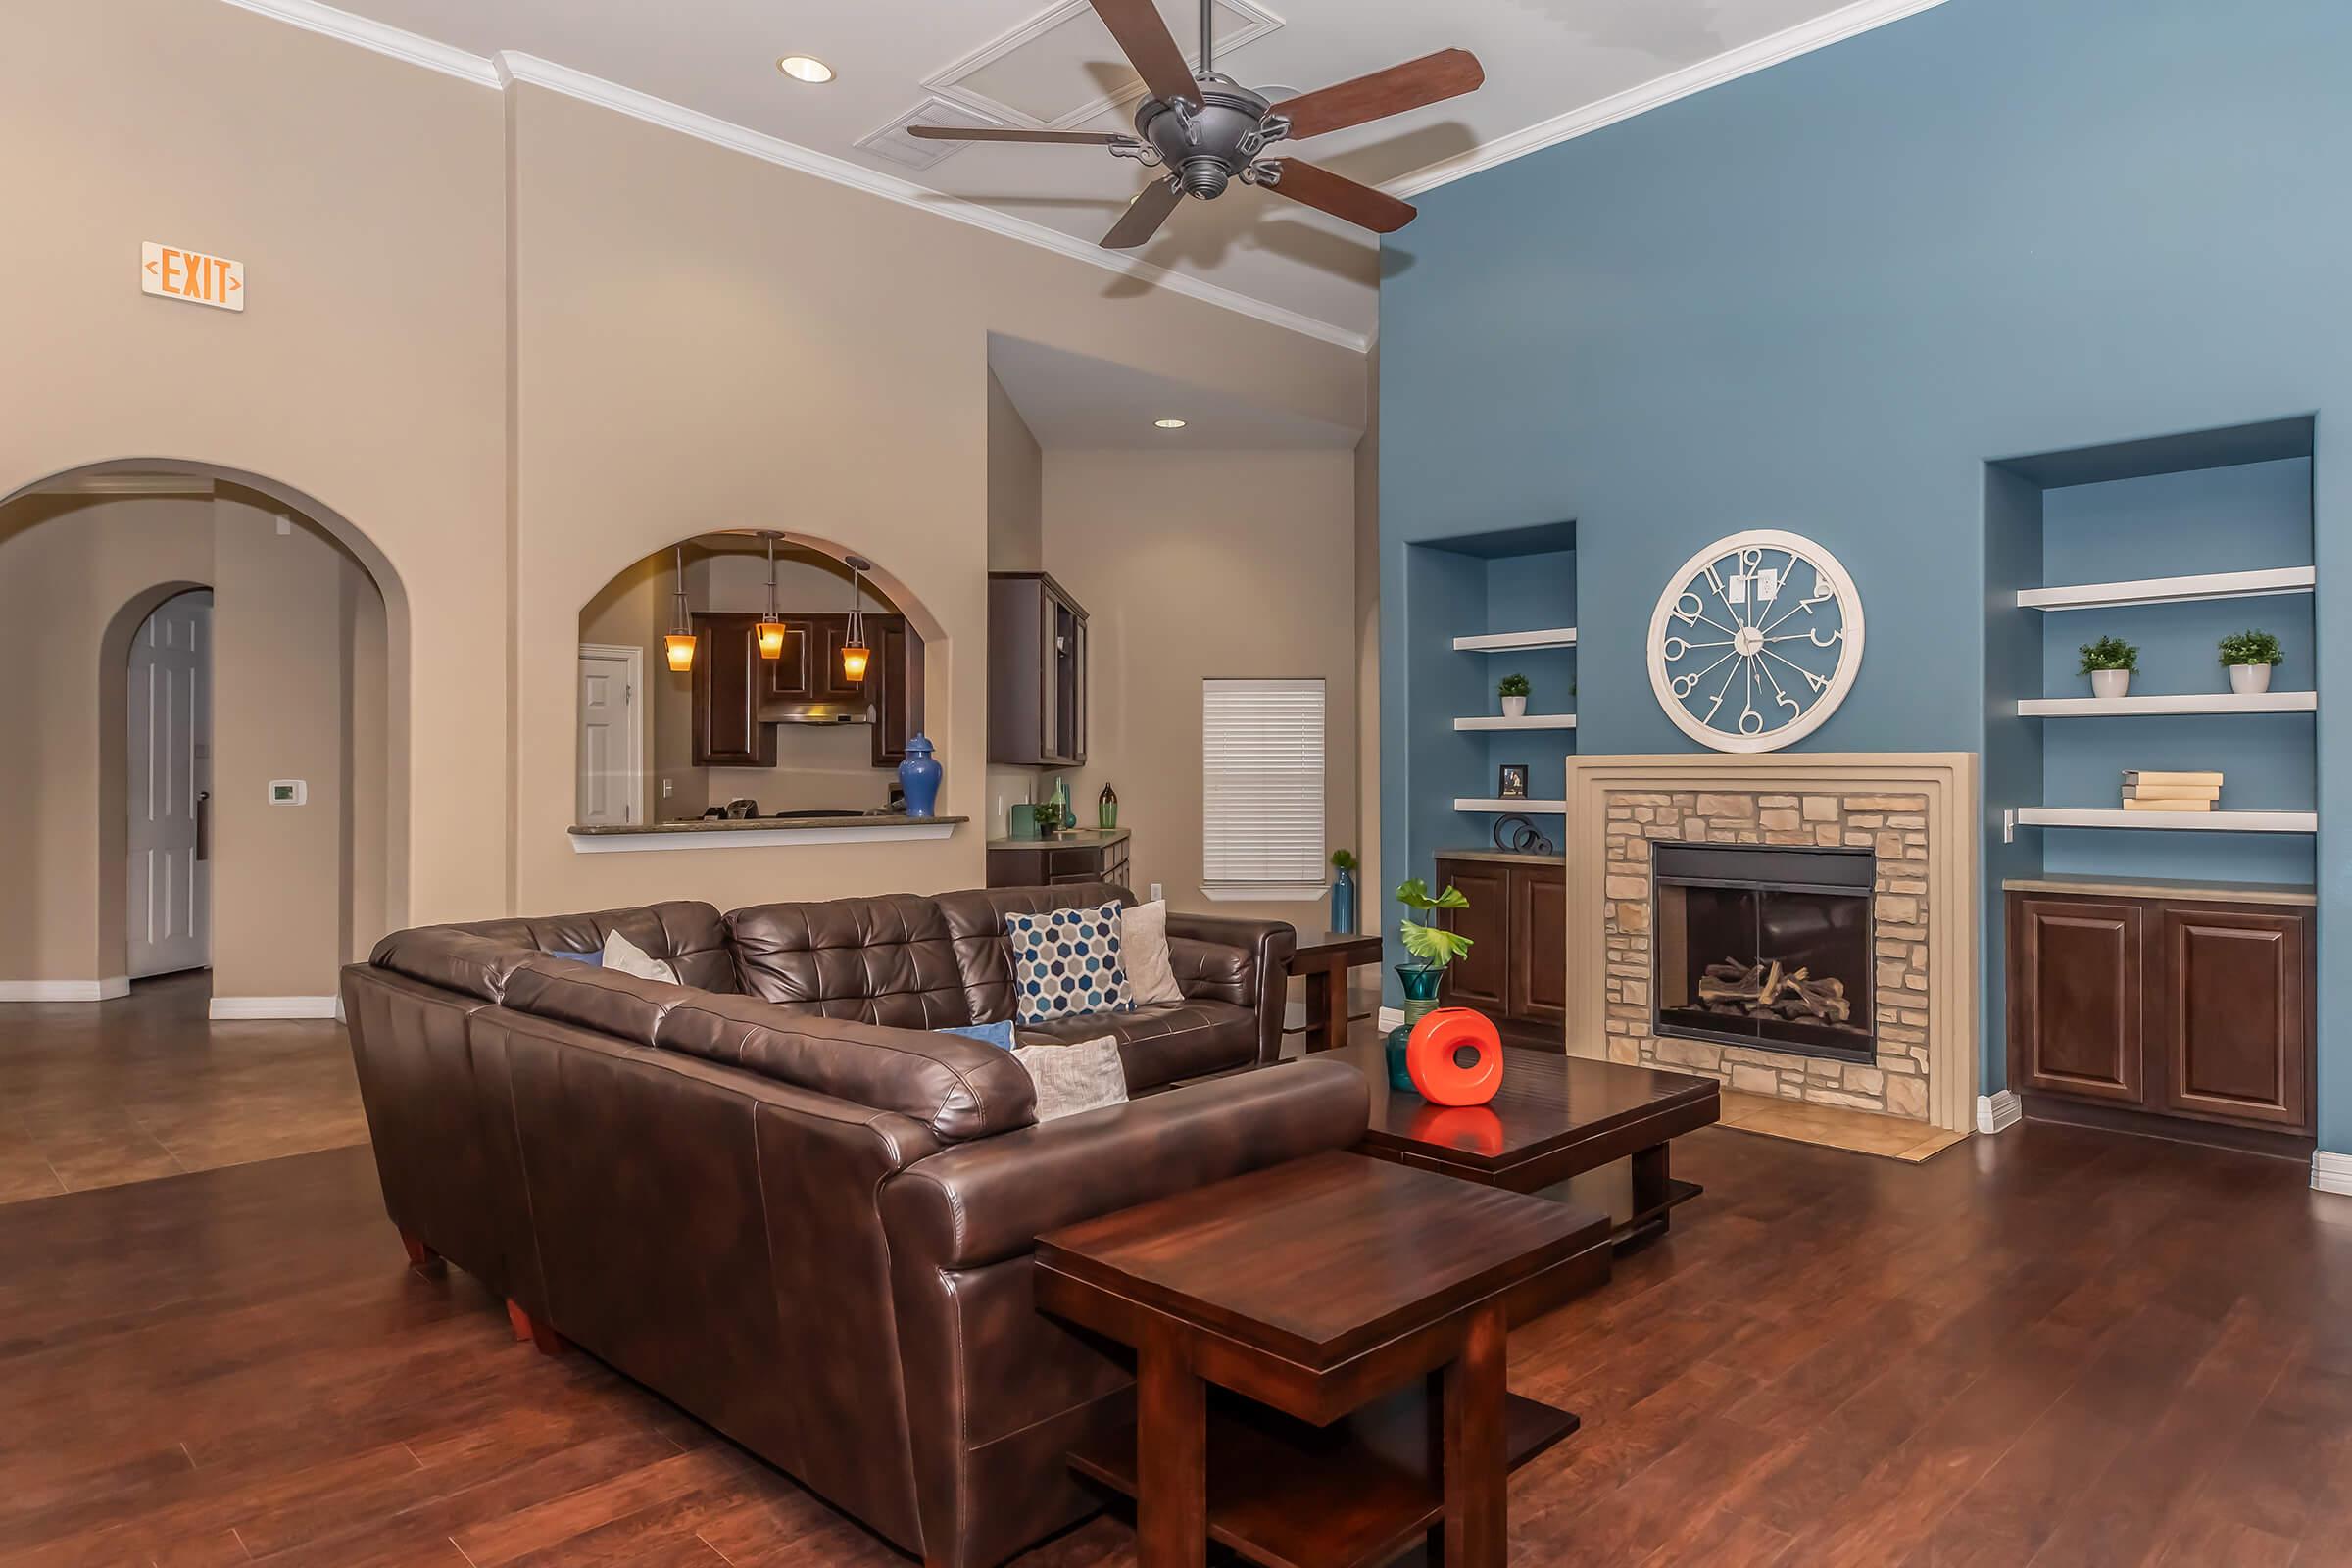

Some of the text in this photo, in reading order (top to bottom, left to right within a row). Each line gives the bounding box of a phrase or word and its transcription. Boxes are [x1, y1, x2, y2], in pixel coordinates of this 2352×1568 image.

[162, 247, 231, 303] EXIT
[1671, 673, 1698, 698] 8
[1803, 671, 1833, 693] 4
[1740, 705, 1763, 735] 6
